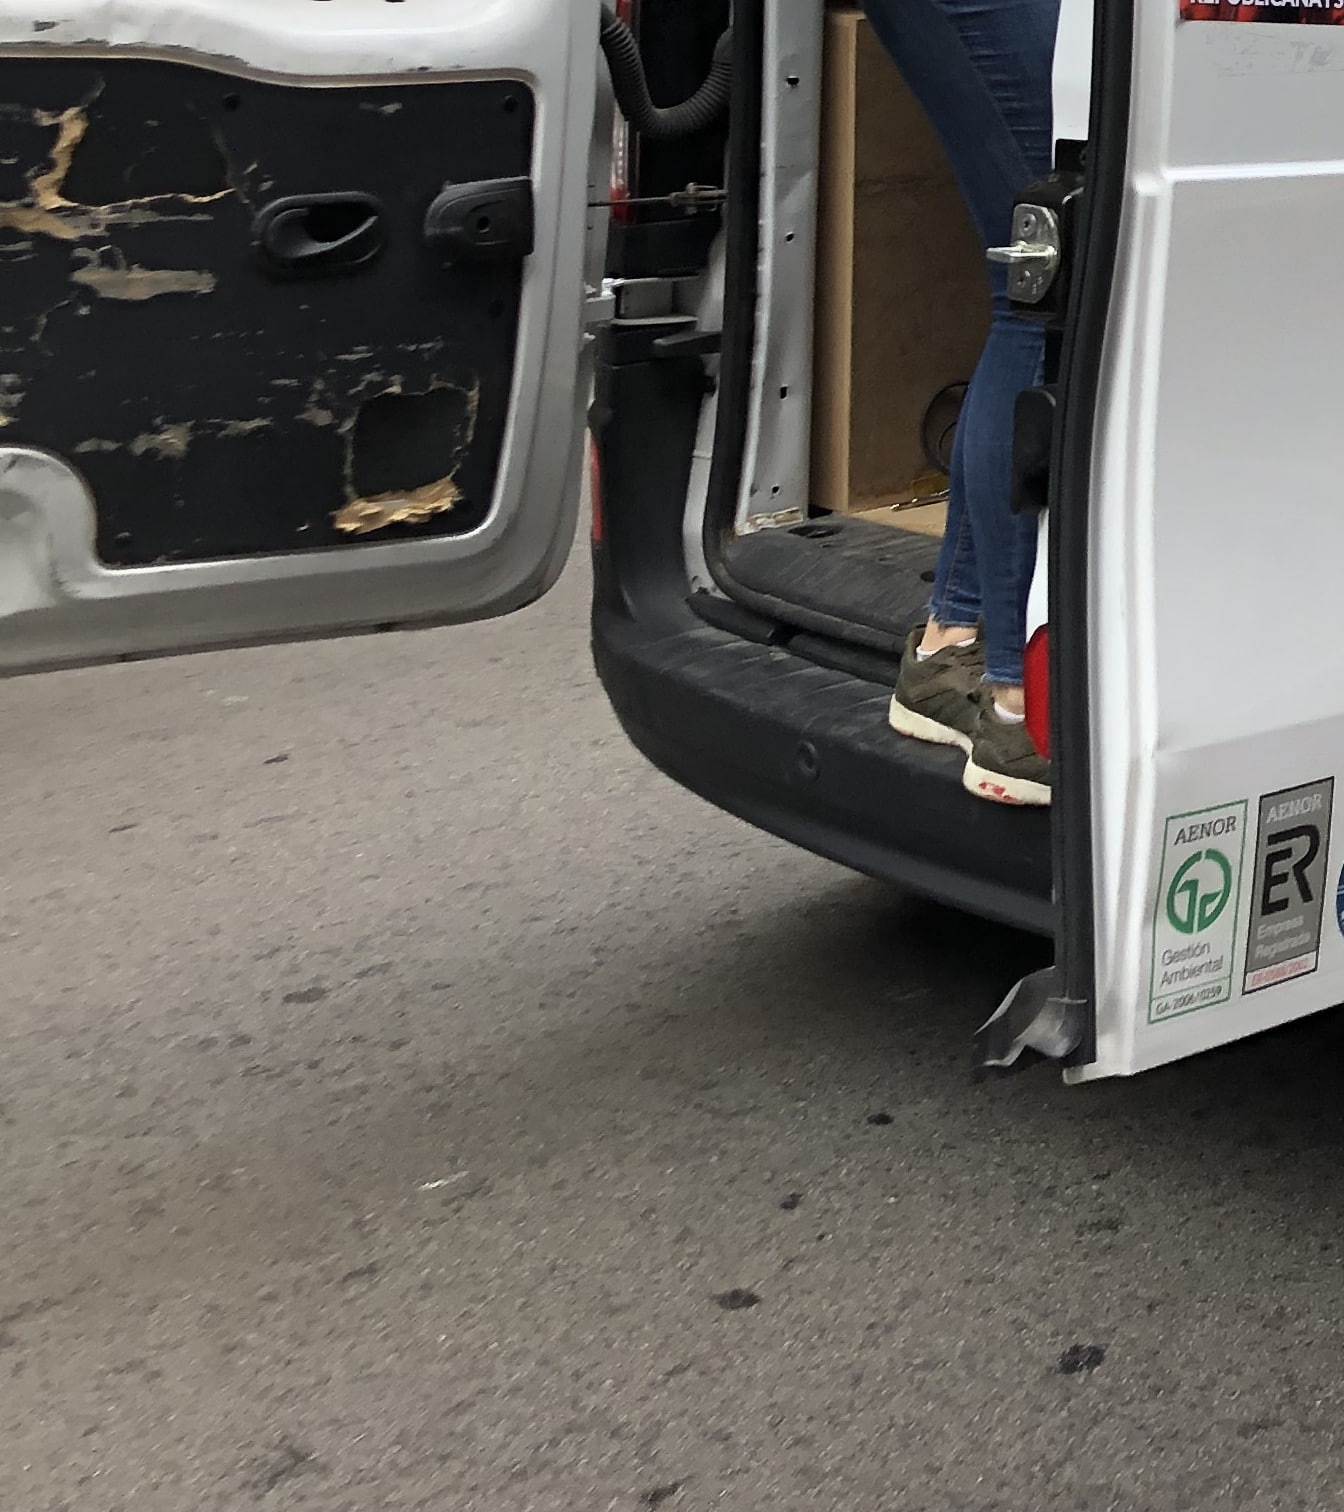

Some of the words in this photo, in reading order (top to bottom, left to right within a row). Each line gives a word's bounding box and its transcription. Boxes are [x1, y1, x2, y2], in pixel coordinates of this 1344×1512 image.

[1266, 793, 1323, 824] AENOR
[1173, 815, 1237, 846] AENOR
[1161, 941, 1211, 967] Gestión
[1160, 954, 1224, 988] Ambiental
